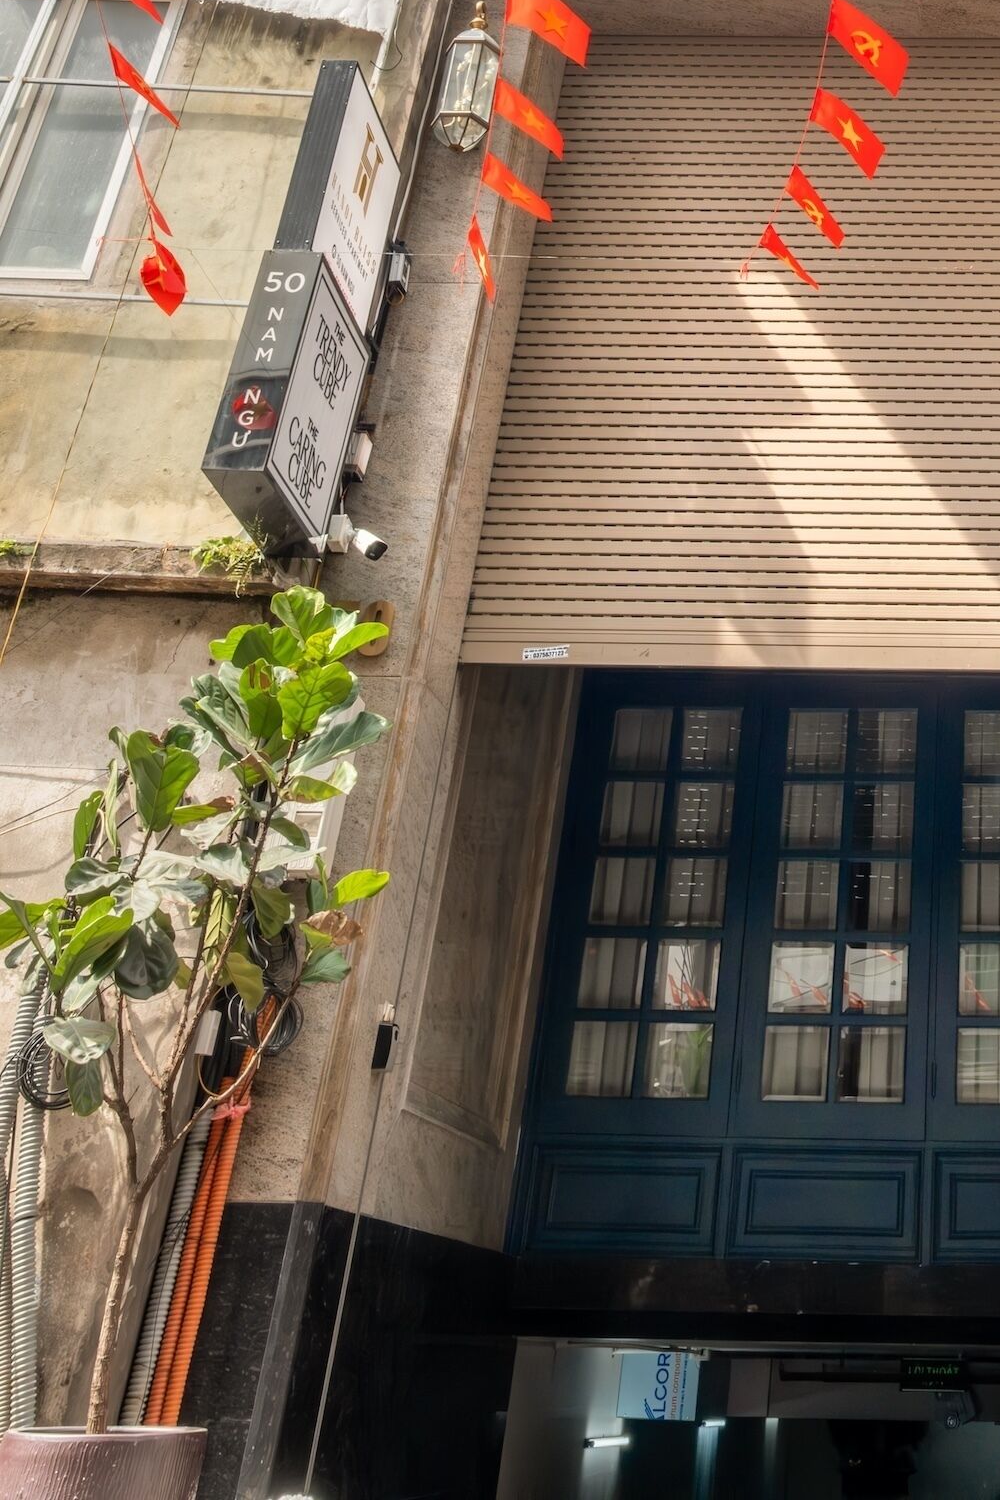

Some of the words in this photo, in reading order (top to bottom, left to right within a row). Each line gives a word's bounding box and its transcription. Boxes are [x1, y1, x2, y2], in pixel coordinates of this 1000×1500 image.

[354, 225, 377, 275] BLISS
[264, 271, 306, 293] 50
[255, 307, 285, 362] NAM
[315, 314, 352, 392] TRENDY
[334, 320, 346, 347] THE
[313, 353, 340, 410] CUBE
[289, 416, 327, 489] CARING
[307, 416, 320, 443] THE
[288, 453, 316, 509] CUBE
